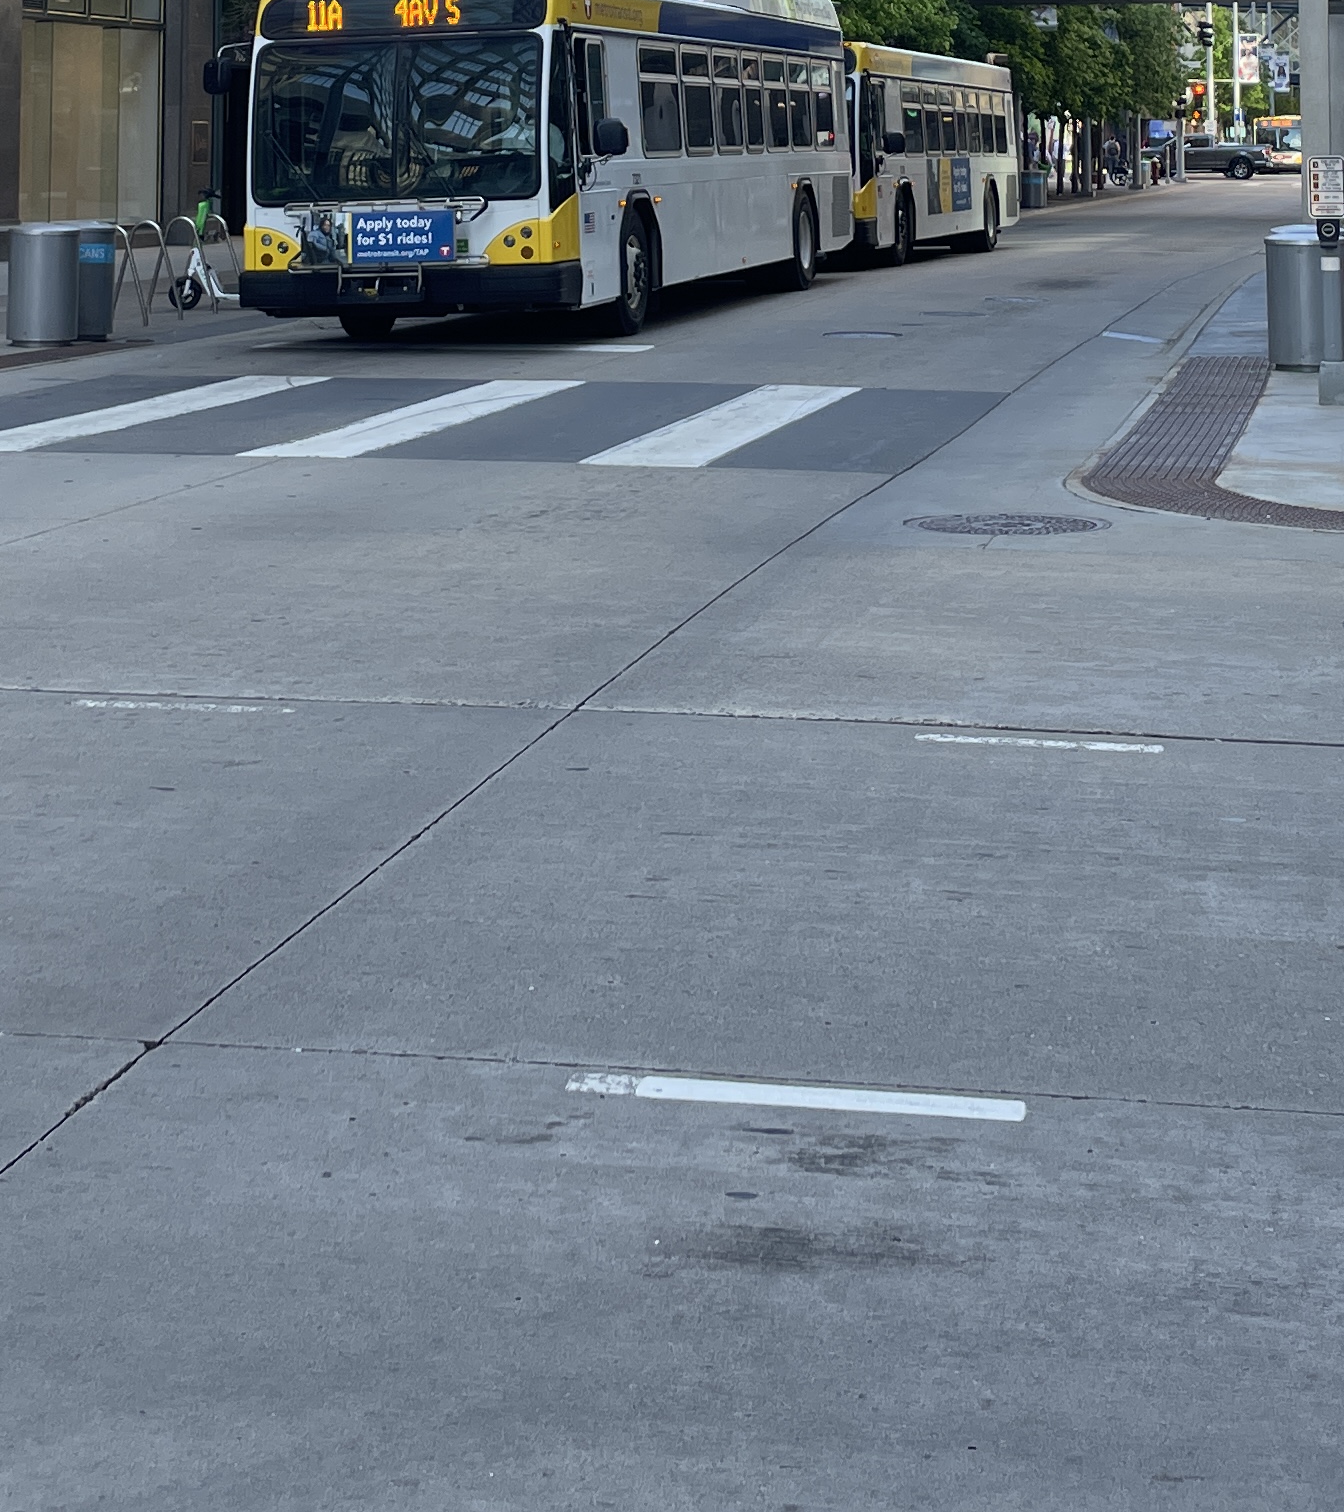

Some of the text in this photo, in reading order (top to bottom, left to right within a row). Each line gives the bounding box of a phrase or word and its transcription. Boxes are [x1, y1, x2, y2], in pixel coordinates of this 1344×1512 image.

[356, 215, 433, 232] Apply today
[356, 232, 433, 246] for $1 rides!
[356, 248, 430, 258] metrotransit.org/TAP
